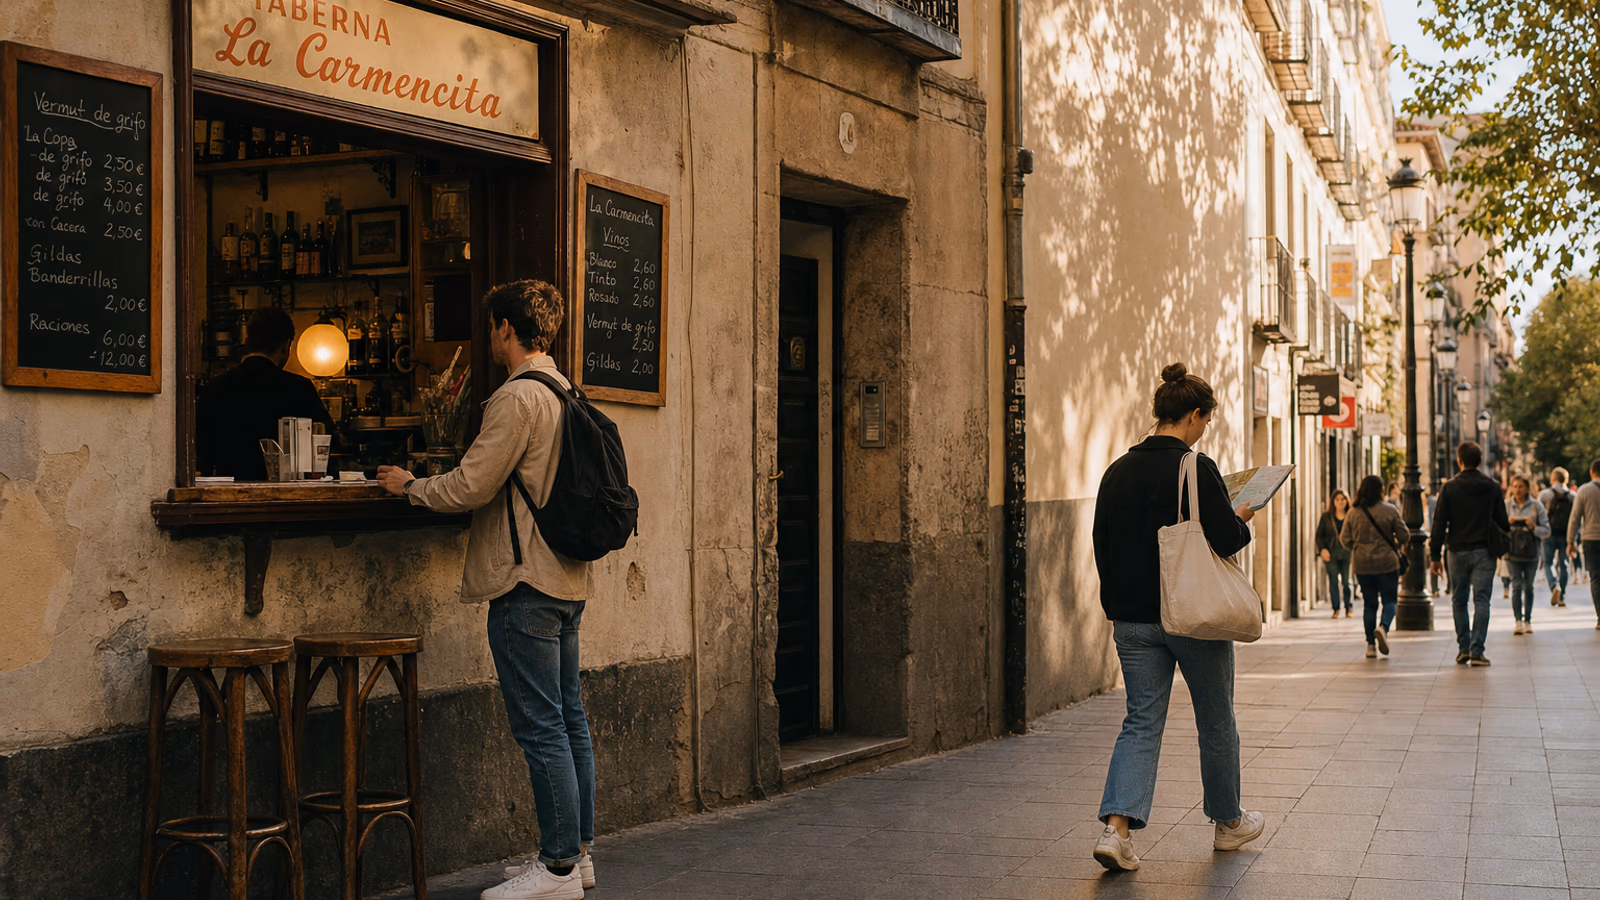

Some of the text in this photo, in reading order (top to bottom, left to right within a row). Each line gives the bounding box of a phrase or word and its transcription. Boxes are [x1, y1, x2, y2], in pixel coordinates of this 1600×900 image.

[215, 17, 502, 119] La Carmencita
[34, 91, 146, 141] Vermut de grifo
[25, 125, 77, 151] La Copa
[62, 151, 92, 172] grifo
[36, 166, 52, 182] de
[59, 170, 87, 192] grifo
[33, 186, 49, 202] de
[56, 191, 84, 212] grifo
[590, 194, 655, 227] La Carmencita
[603, 227, 630, 247] Vinos
[27, 243, 82, 266] Gildas
[589, 251, 656, 274] Blanco 2,60
[28, 267, 118, 290] Banderrillas
[588, 271, 656, 291] Tinto 2,60
[589, 287, 655, 308] Rosado 2,60
[29, 313, 90, 335] Raciones
[621, 317, 632, 331] de
[634, 320, 656, 339] grifo
[632, 337, 655, 352] 2,50
[586, 352, 654, 375] Gildas 2,00
